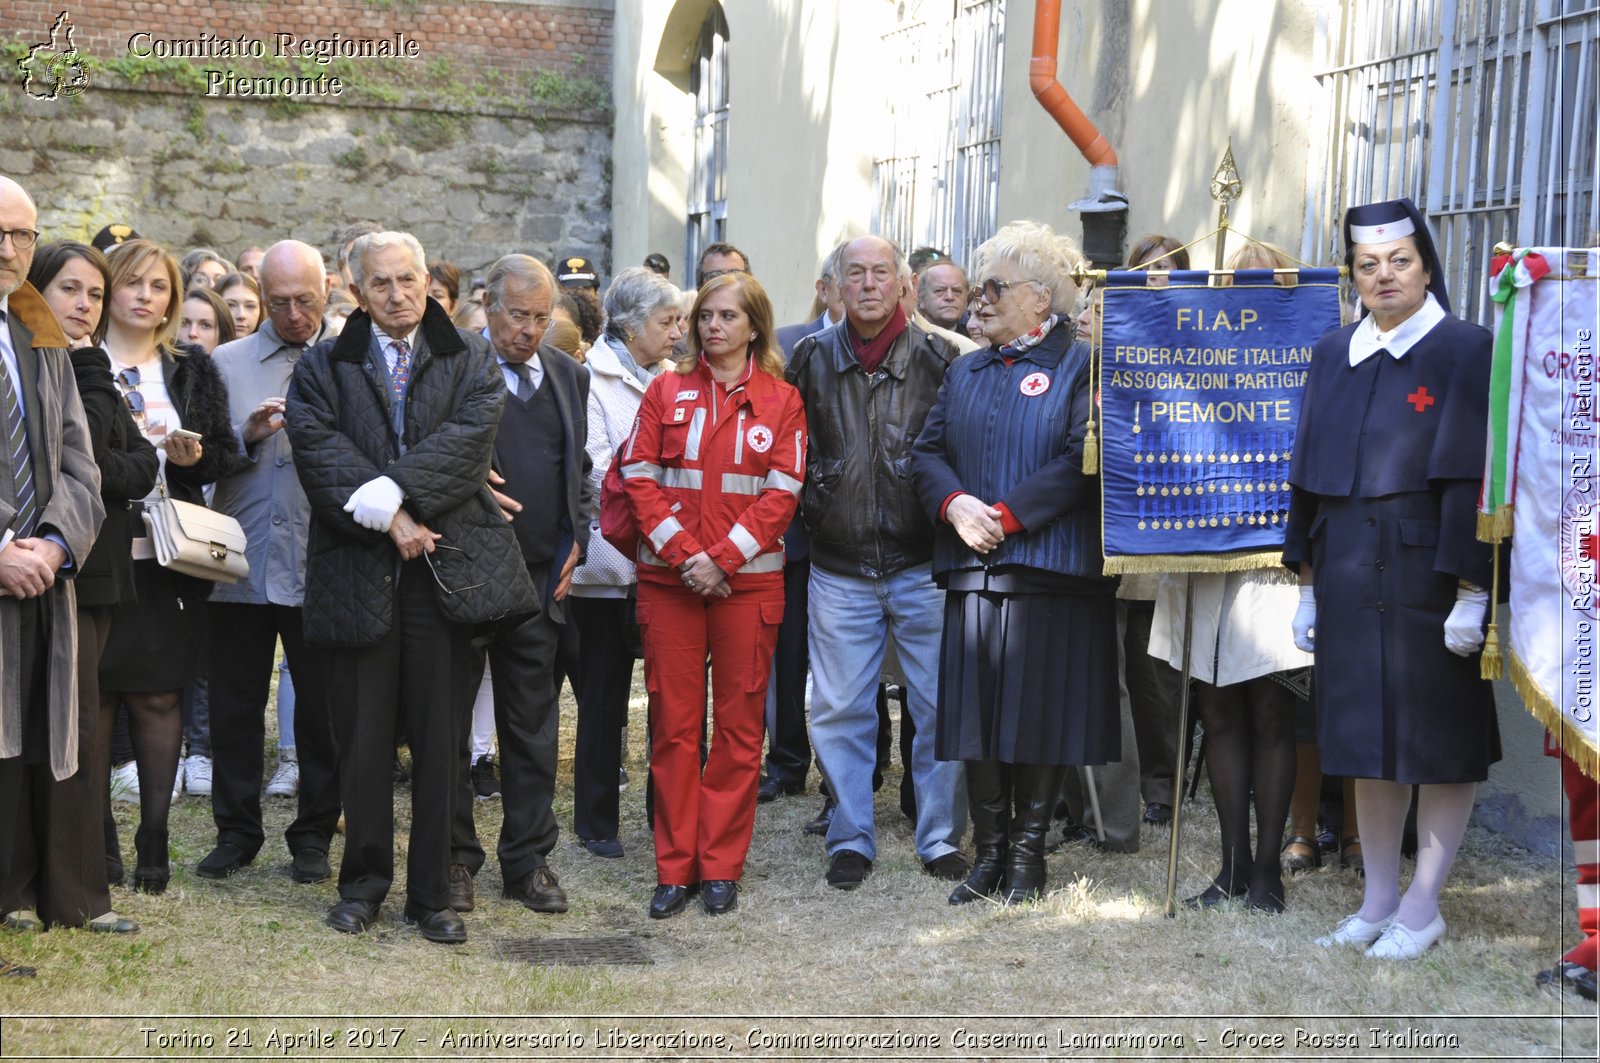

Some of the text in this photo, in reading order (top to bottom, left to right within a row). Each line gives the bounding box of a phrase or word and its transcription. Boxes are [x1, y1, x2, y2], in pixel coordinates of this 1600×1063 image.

[1176, 308, 1263, 331] F.I.A.P.
[1115, 346, 1313, 366] FEDERAZIONE ITALIAN
[1110, 370, 1309, 390] ASSOCIAZIONI PARTIGIA
[1151, 400, 1291, 424] PIEMONTE
[1551, 428, 1600, 450] COMITAT
